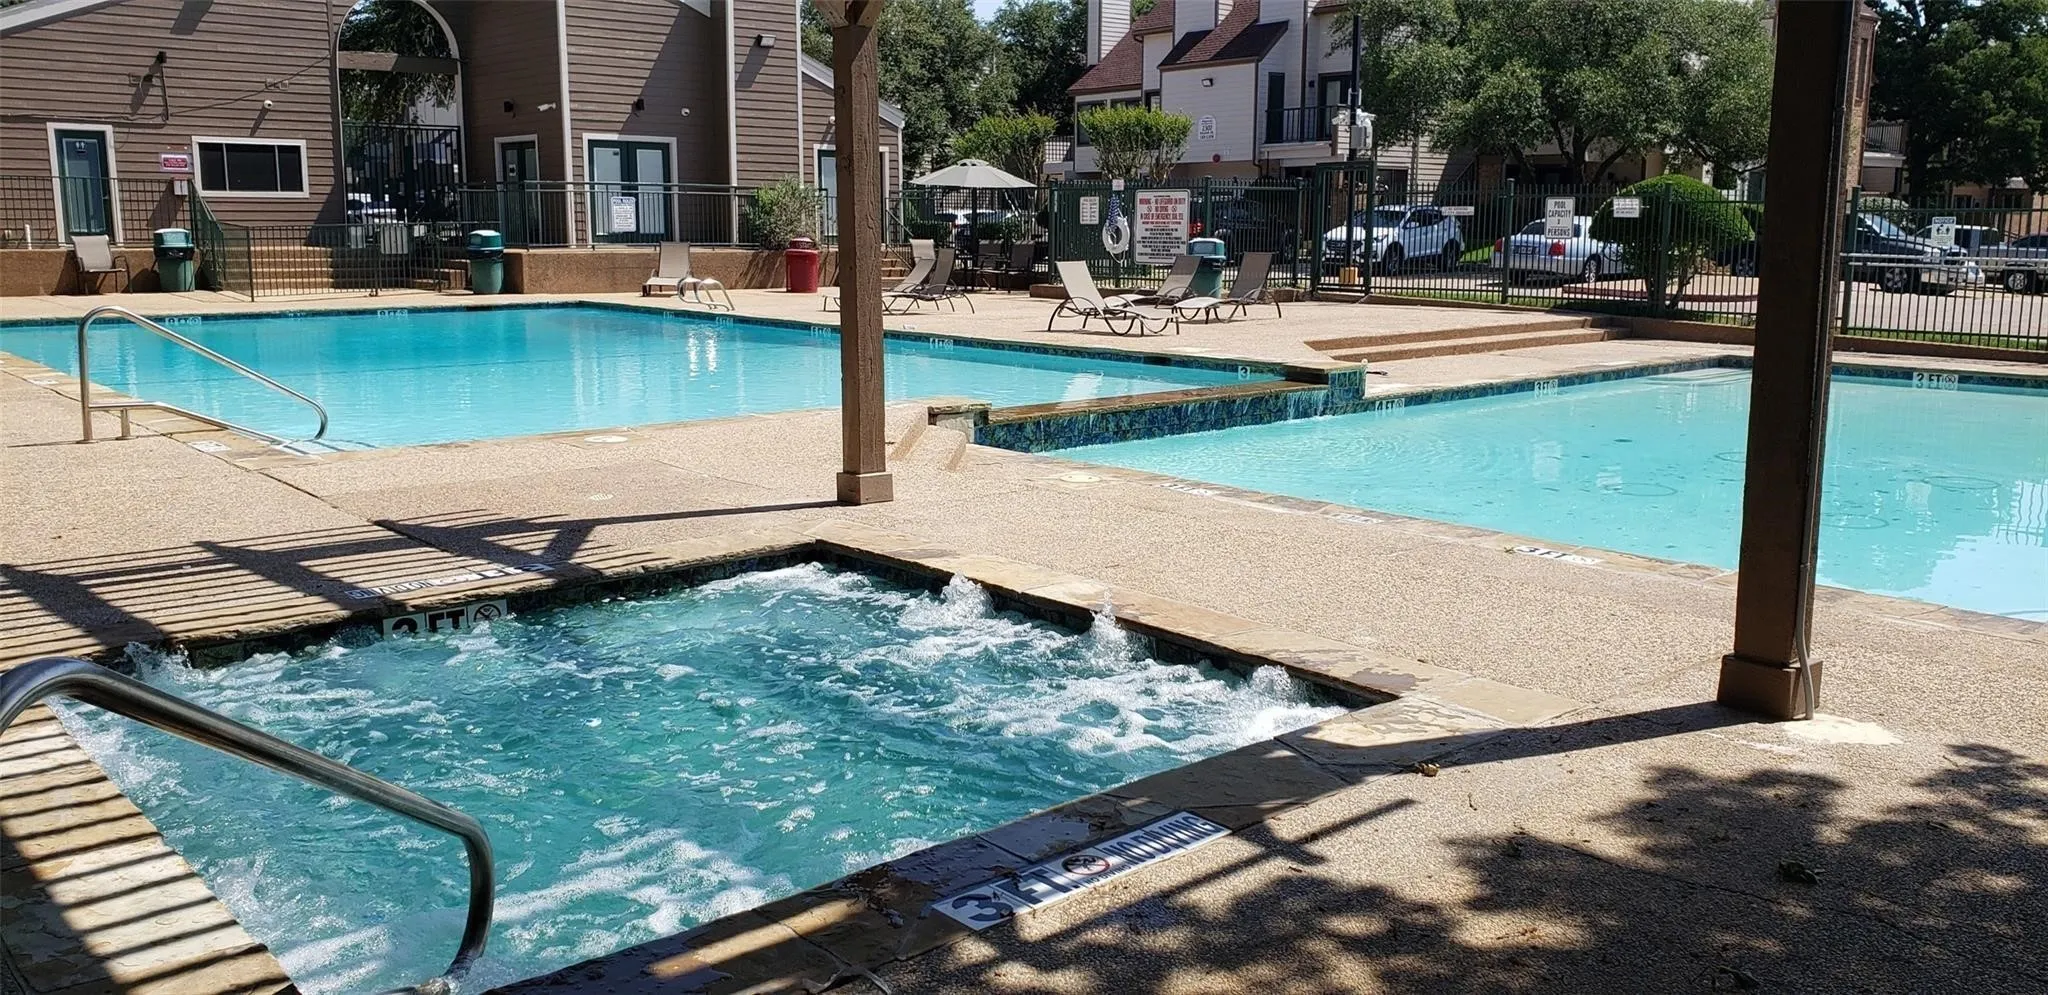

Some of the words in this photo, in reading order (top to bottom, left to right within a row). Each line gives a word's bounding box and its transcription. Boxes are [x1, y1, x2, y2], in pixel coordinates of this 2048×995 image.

[1554, 201, 1566, 209] POOL
[1548, 209, 1571, 218] CAPACITY
[1548, 228, 1571, 237] PERSONS
[1538, 550, 1573, 559] FT
[1102, 841, 1157, 865] NO
[1130, 815, 1225, 855] DIVING
[951, 892, 1013, 922] 3
